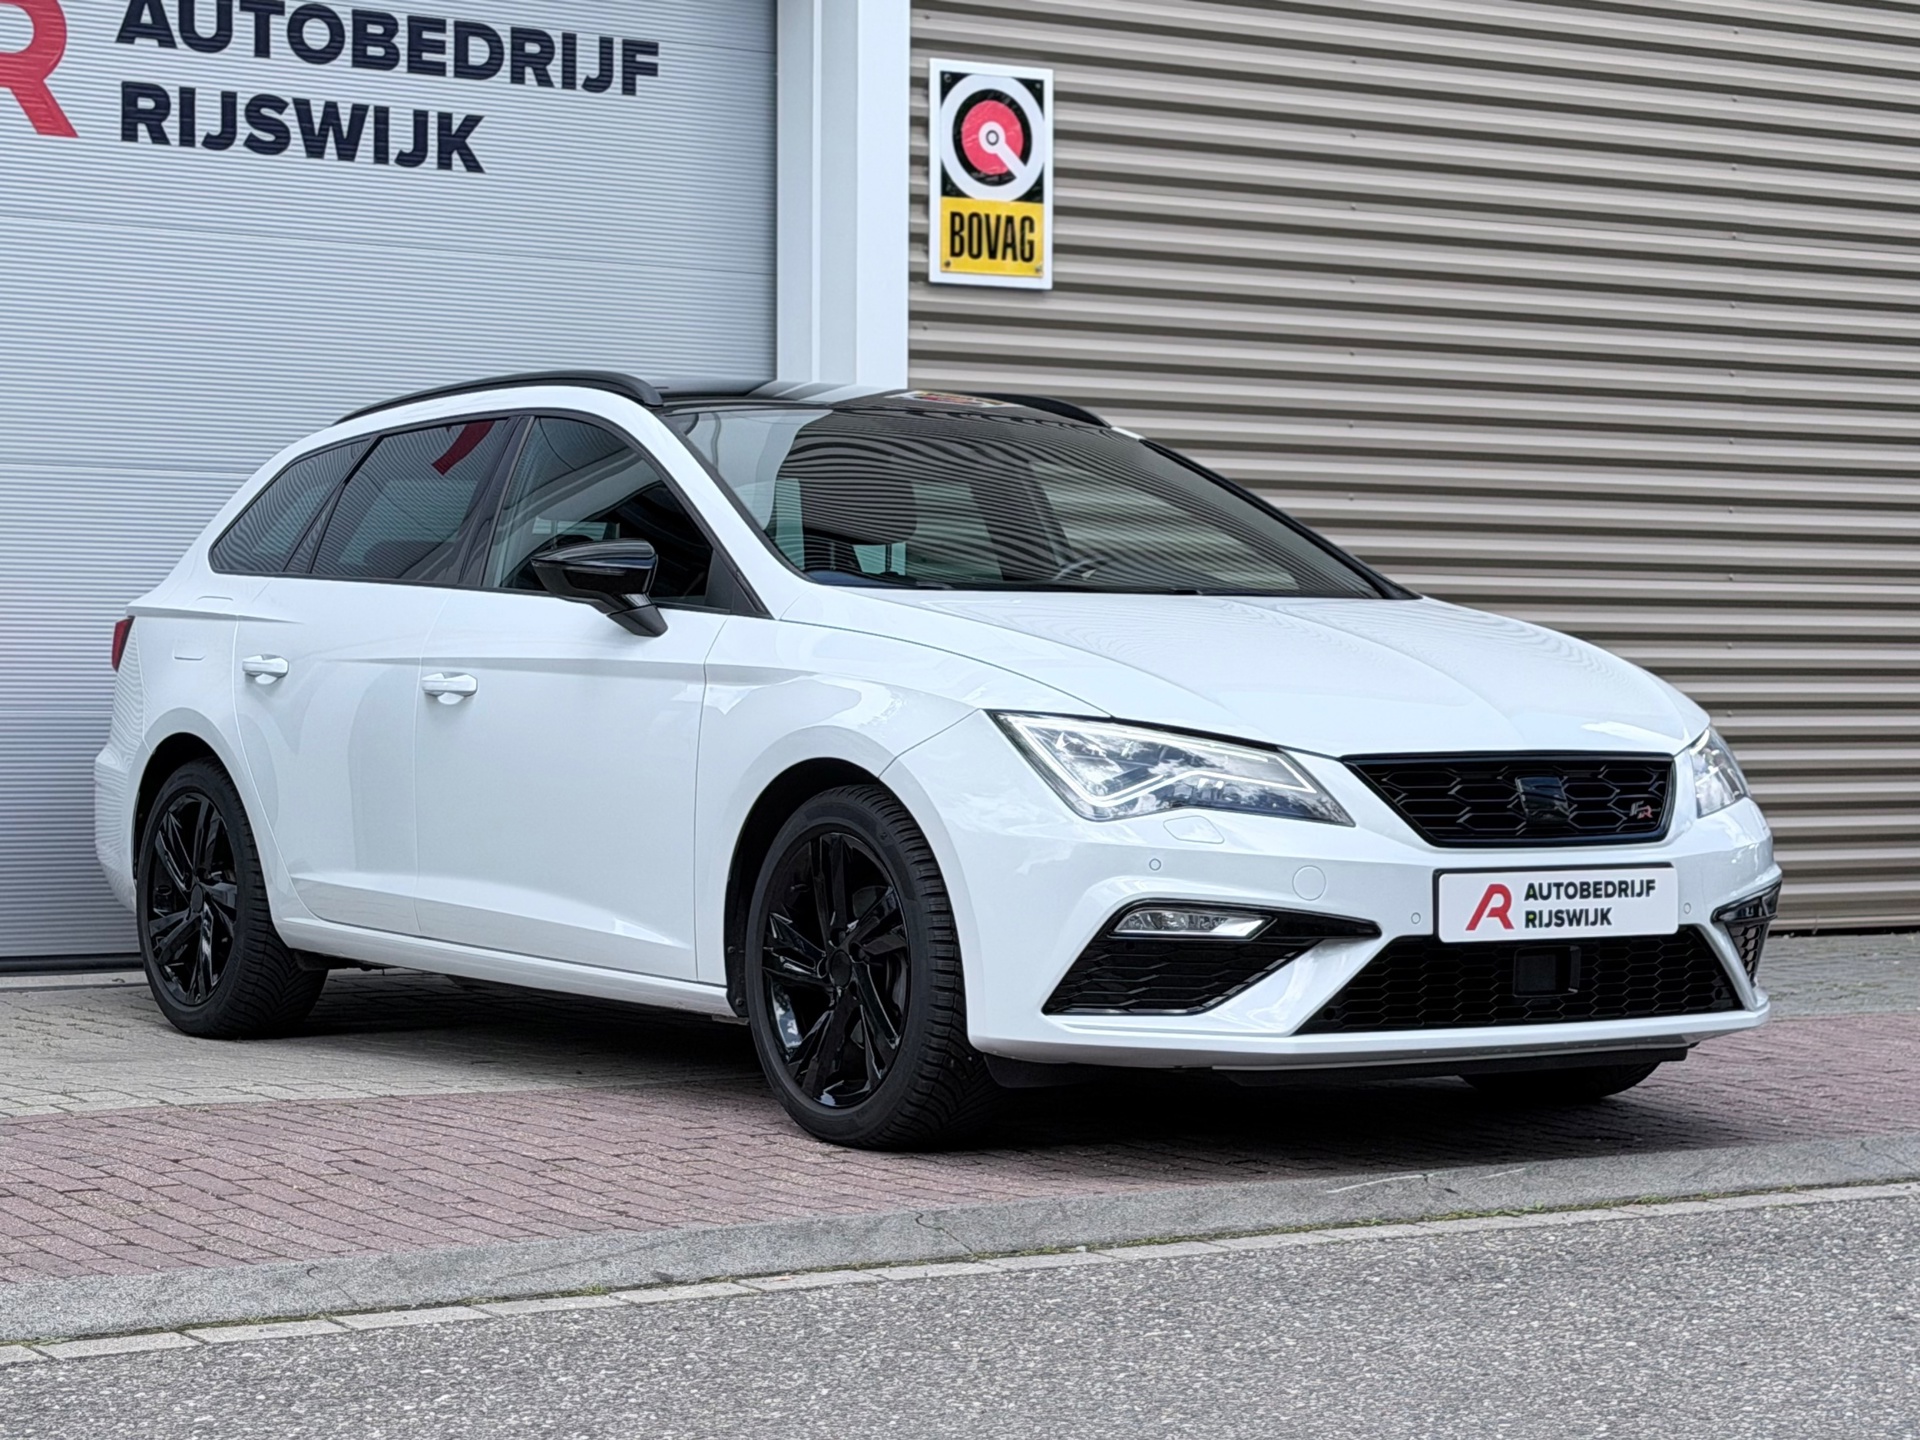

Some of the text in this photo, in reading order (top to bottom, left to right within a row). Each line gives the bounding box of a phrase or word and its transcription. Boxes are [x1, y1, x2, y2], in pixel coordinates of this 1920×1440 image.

[115, 0, 659, 96] AUTOBEDRIJF
[120, 81, 486, 174] RIJSWIJK
[950, 211, 1035, 263] BOVAG
[1524, 879, 1656, 901] AUTOBEDRIJF
[1524, 907, 1613, 929] RIJSWIJK
